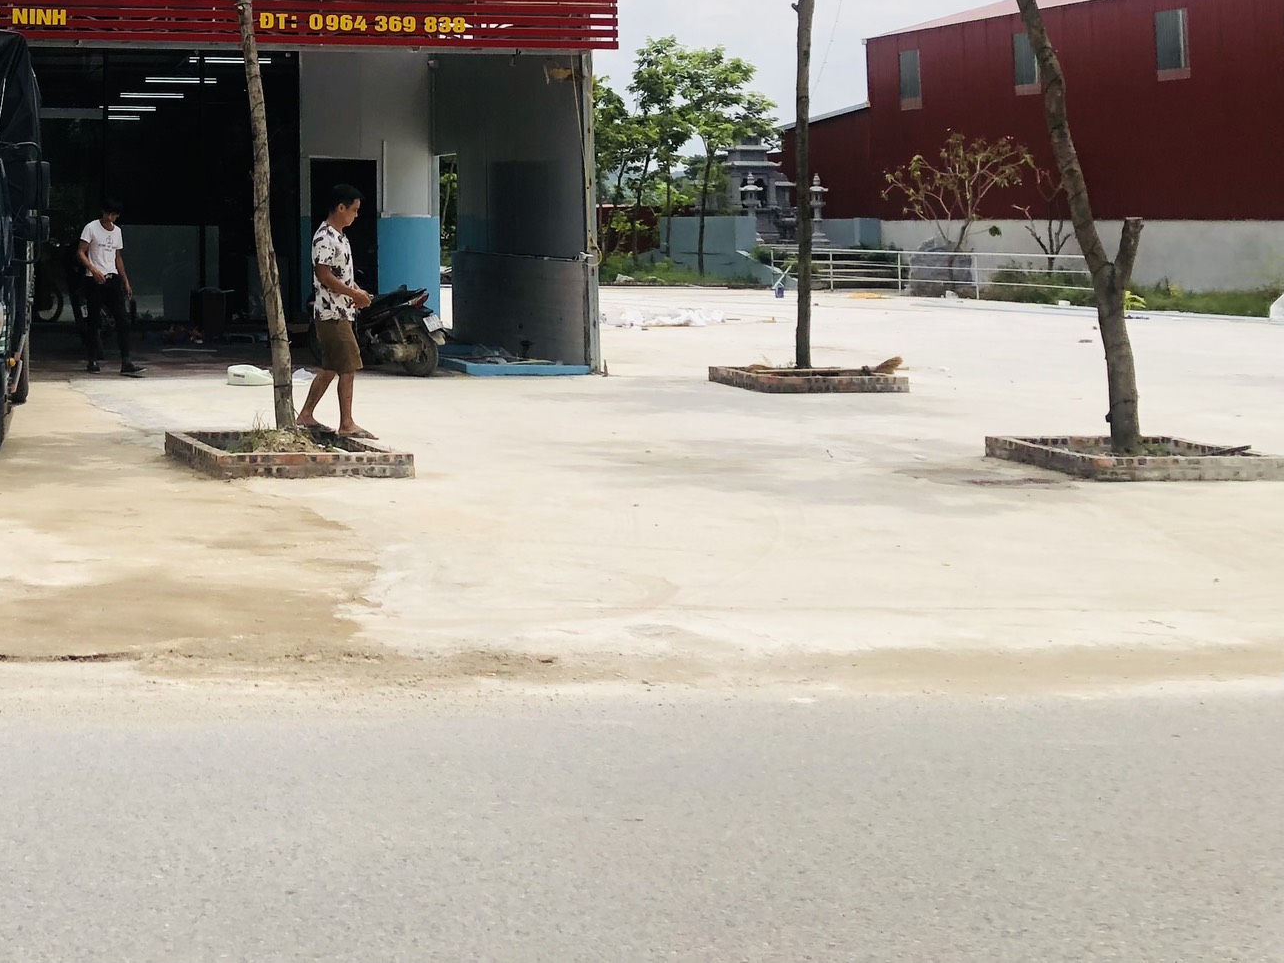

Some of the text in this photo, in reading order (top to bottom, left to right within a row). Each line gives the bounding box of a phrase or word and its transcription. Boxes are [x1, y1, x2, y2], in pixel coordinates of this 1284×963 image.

[12, 7, 67, 26] NINH
[259, 13, 467, 34] ĐT: 0964 369 838
